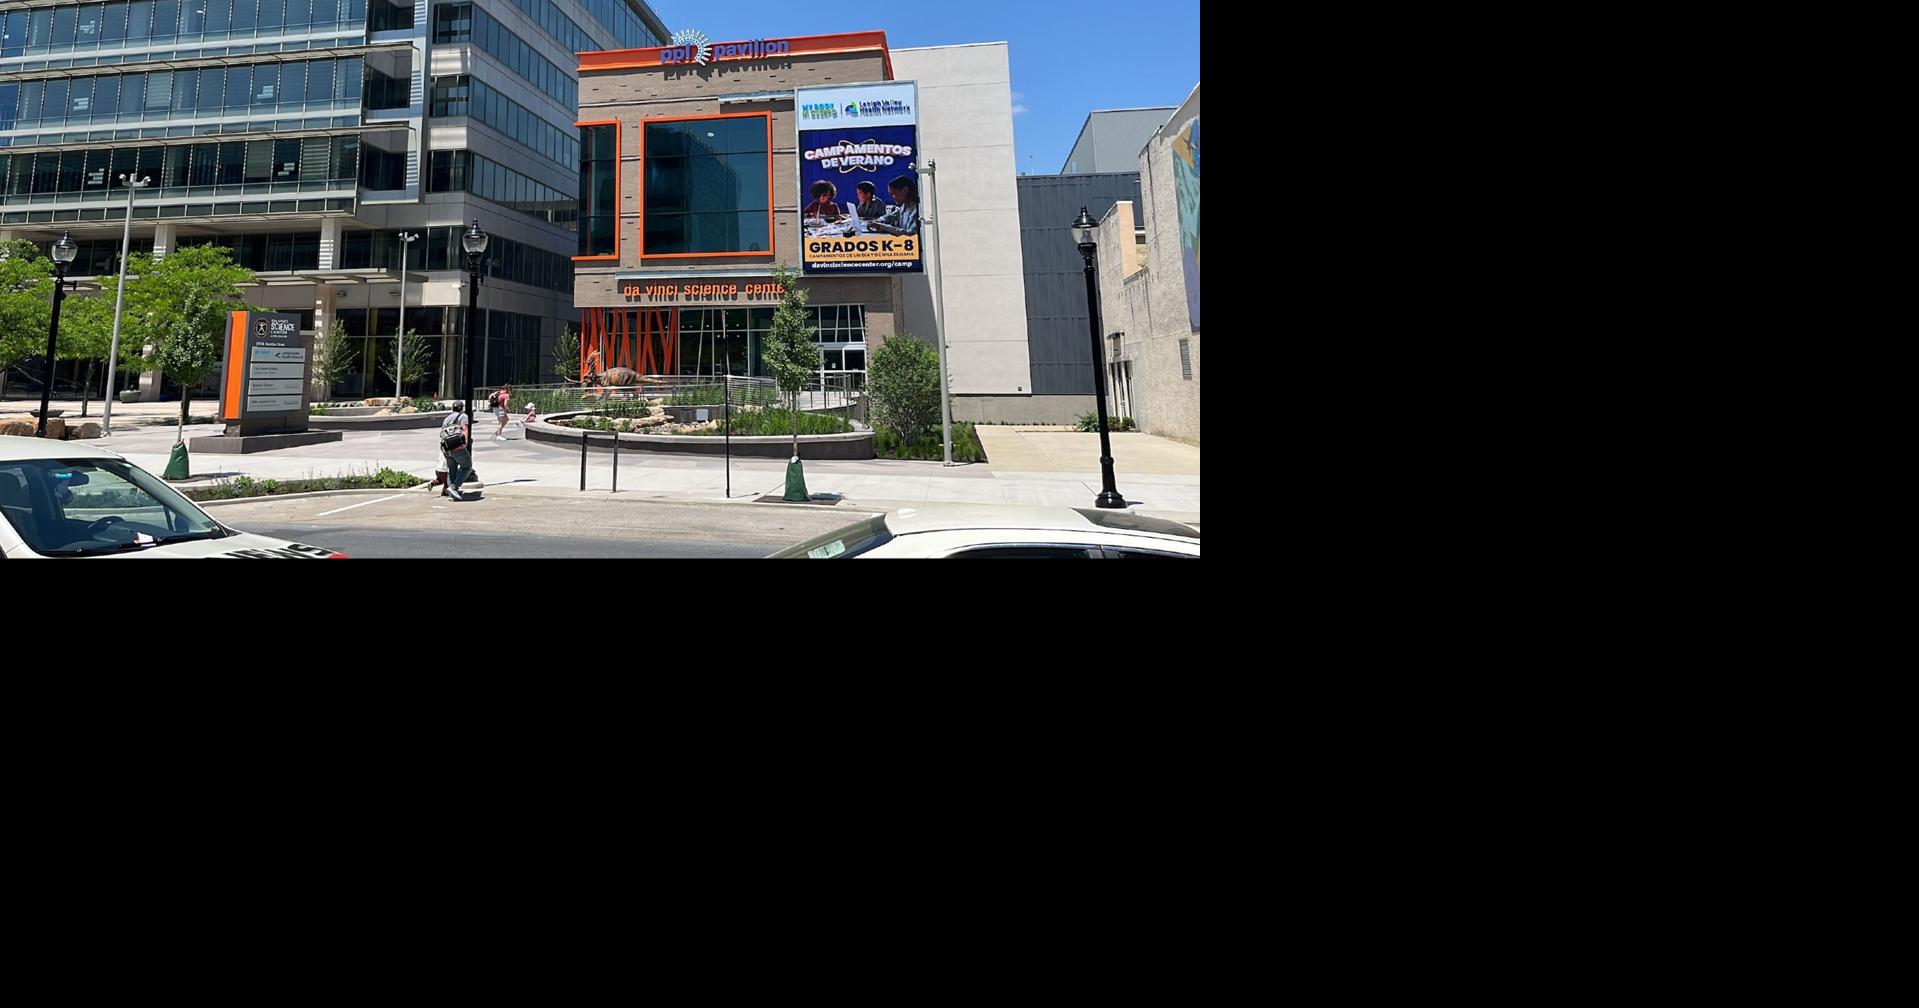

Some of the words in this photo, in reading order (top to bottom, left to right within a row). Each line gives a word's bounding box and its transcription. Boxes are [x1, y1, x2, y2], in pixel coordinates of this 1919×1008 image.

[660, 43, 691, 64] ppl
[714, 39, 789, 60] pavilion
[804, 144, 912, 160] CAMPAMENTOS
[821, 159, 838, 169] DE
[840, 155, 894, 166] VERANO
[809, 241, 878, 253] GRADOS
[623, 283, 640, 296] da
[645, 281, 678, 296] vinci
[683, 281, 737, 295] science
[270, 322, 295, 331] SCIENCE
